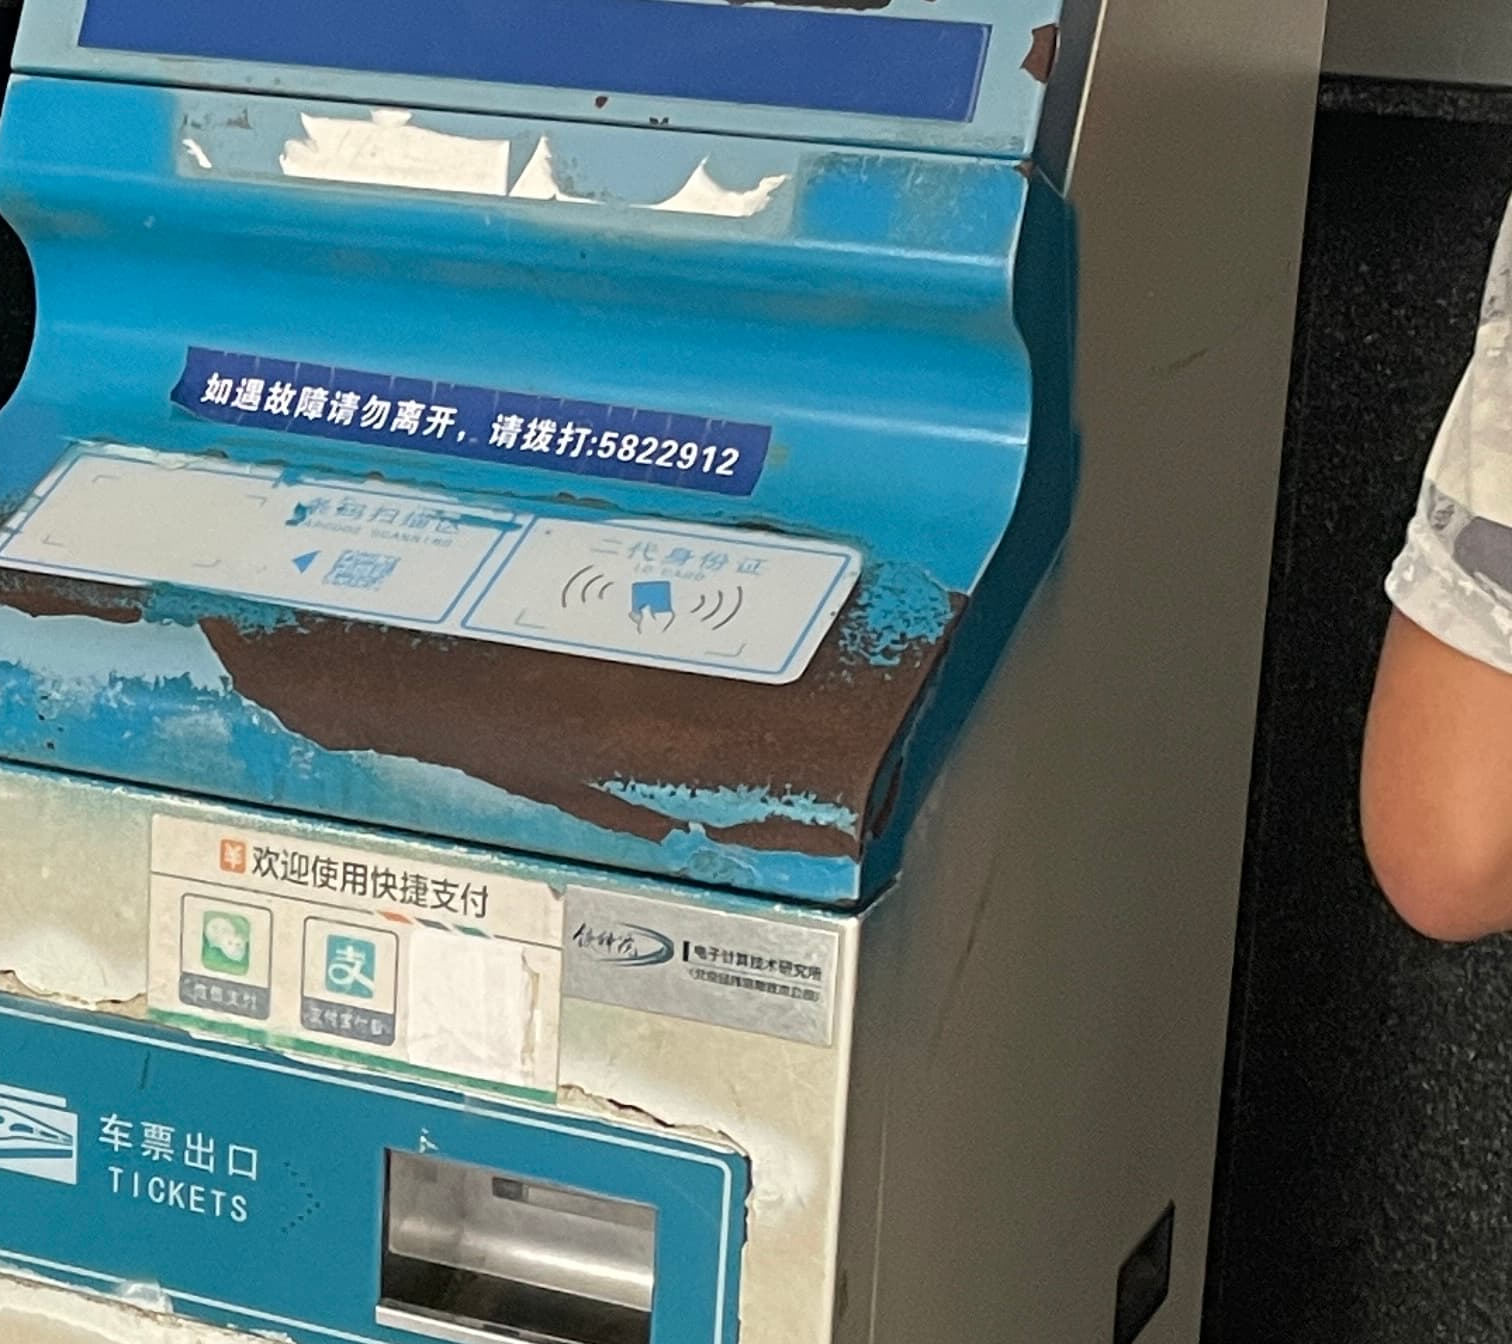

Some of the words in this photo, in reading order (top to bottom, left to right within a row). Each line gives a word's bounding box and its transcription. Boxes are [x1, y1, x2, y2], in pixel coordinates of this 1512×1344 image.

[590, 538, 769, 576] 二代身份证
[252, 845, 489, 920] 欢迎使用快捷支付
[694, 944, 823, 982] 电子计算技术研究所
[100, 1114, 259, 1182] 车票出口
[108, 1165, 250, 1224] TICKETS
